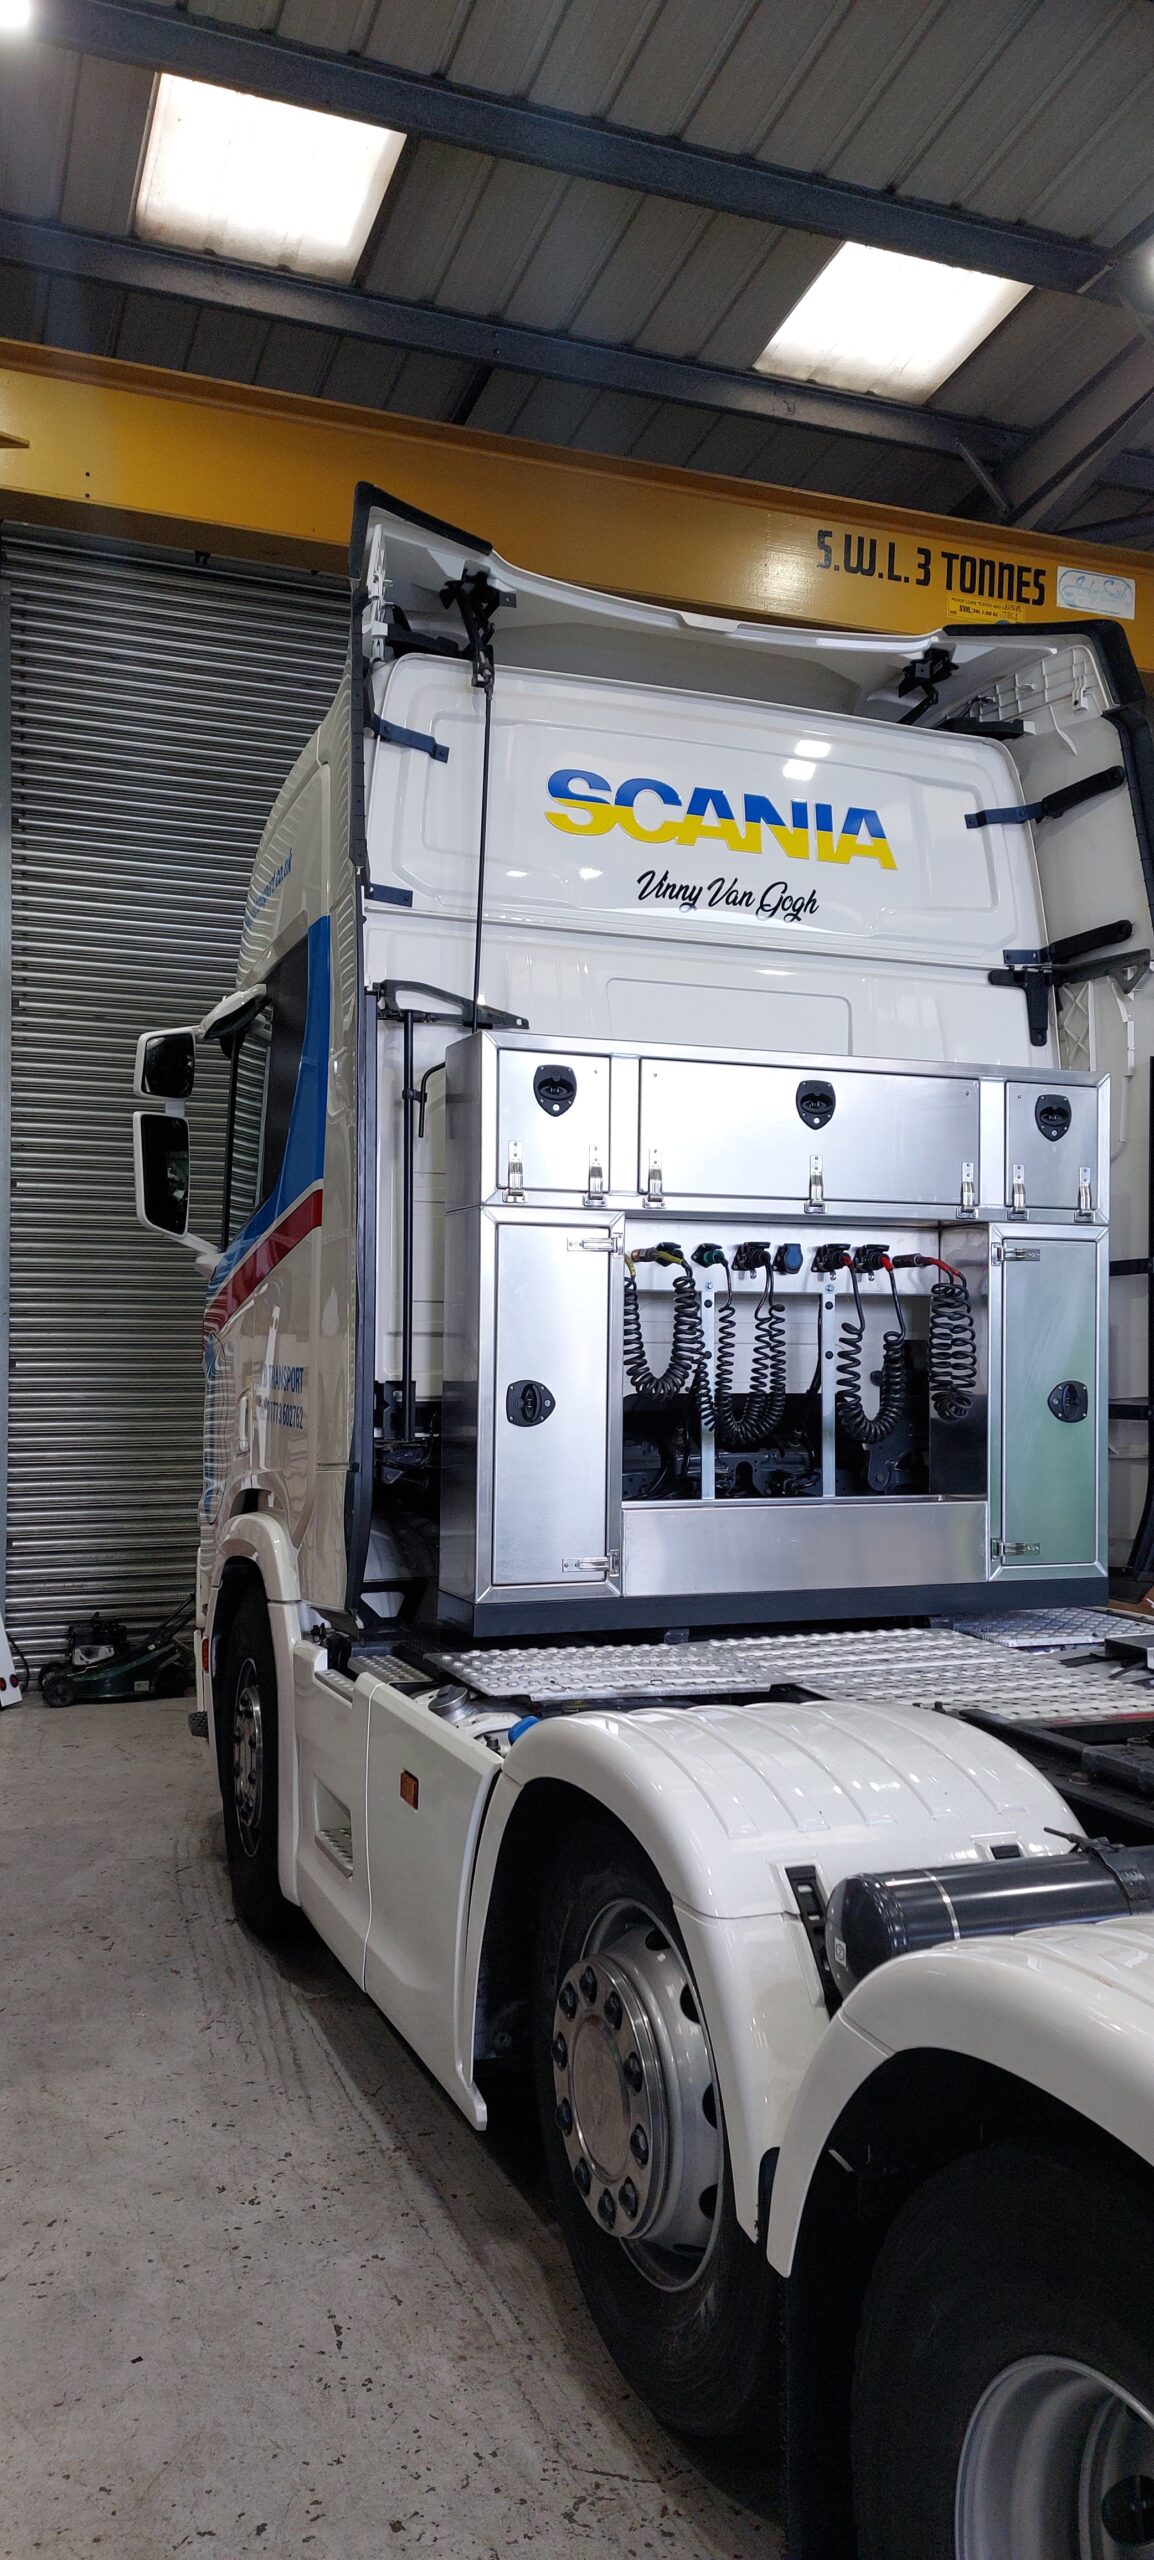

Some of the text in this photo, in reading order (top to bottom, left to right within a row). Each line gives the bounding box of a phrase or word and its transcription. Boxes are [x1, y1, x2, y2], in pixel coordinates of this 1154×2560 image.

[816, 529, 910, 584] S.W.L.
[915, 546, 932, 587] 3
[940, 551, 1047, 607] TONNES
[545, 768, 898, 871] SCANIA
[636, 870, 820, 923] Vinny Van Gogh
[268, 1363, 304, 1394] TRANSPORT
[282, 1402, 304, 1430] 602762
